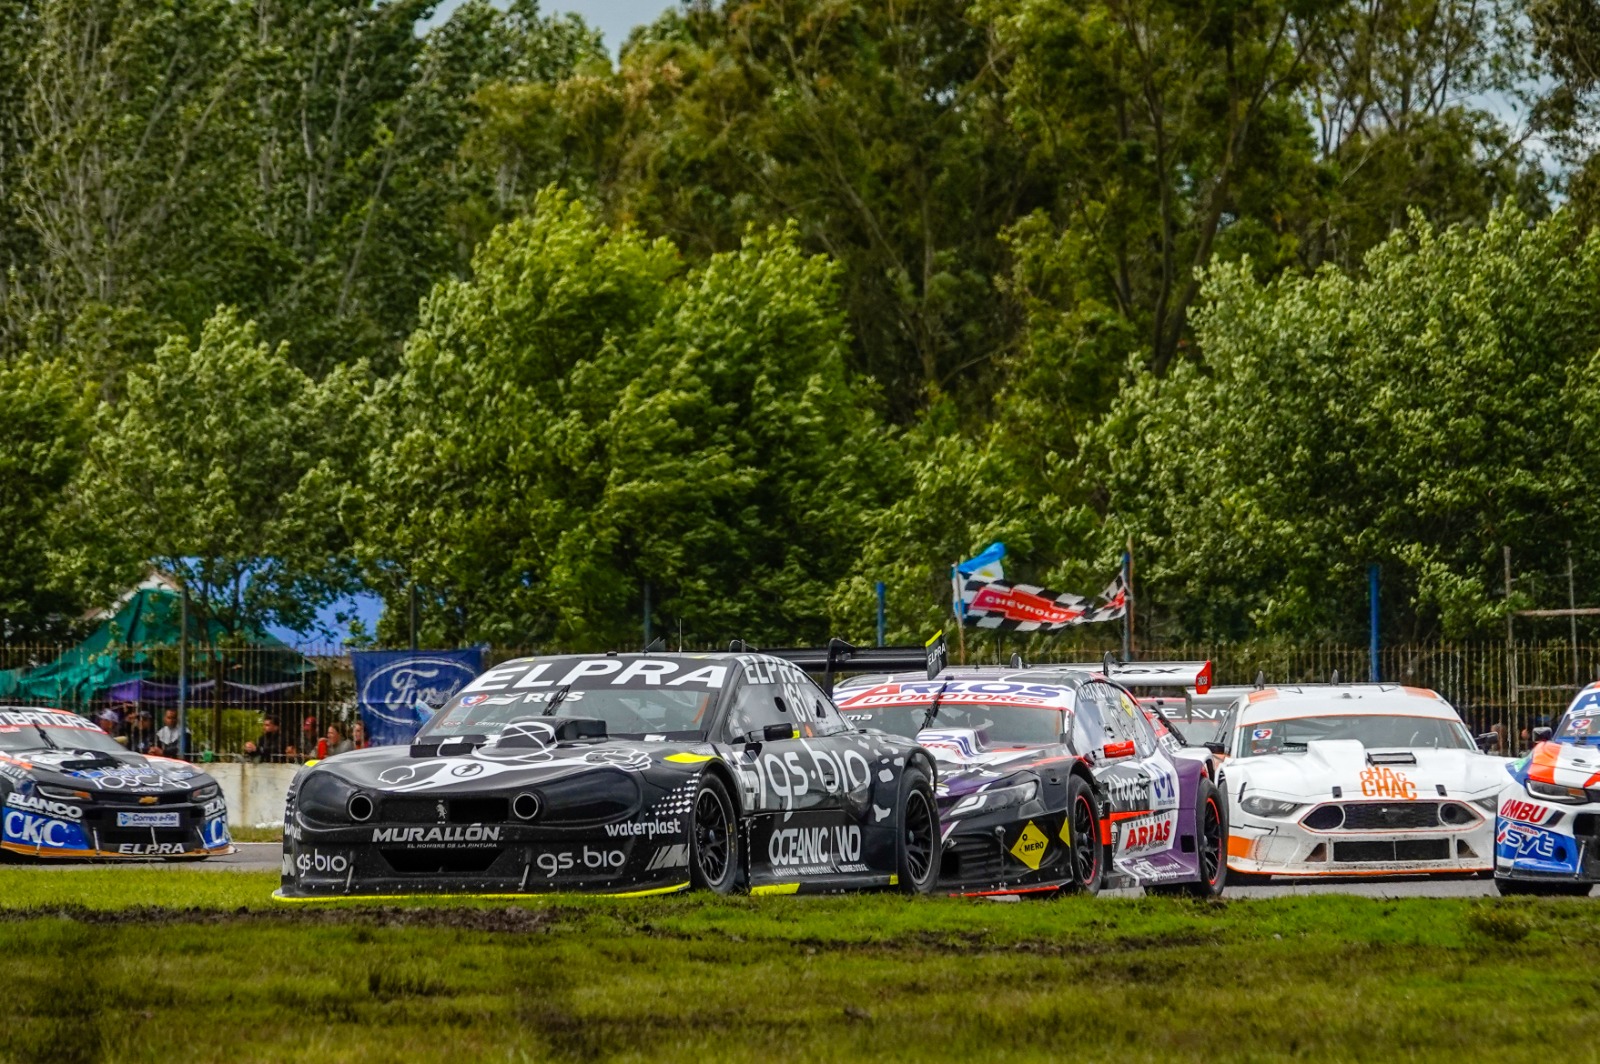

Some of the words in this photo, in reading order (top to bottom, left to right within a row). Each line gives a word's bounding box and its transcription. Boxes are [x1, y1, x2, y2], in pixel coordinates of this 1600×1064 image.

[985, 596, 1067, 619] CHEVROLET
[928, 642, 946, 666] ELPRA
[460, 658, 728, 693] ELPRA
[736, 654, 808, 684] ELPRA
[783, 683, 815, 723] 161
[1359, 765, 1407, 782] CHAC
[1361, 779, 1418, 801] CHAC
[7, 791, 83, 819] BLANCO
[1501, 799, 1548, 823] OMBU
[5, 811, 68, 847] CKC
[372, 823, 501, 842] MURALLÓN
[605, 818, 681, 840] waterplast
[1125, 820, 1170, 850] ARIAS
[118, 842, 185, 854] ELPRA
[769, 827, 828, 866] OCEANIC
[1024, 839, 1044, 851] MERO
[1505, 830, 1555, 857] syt
